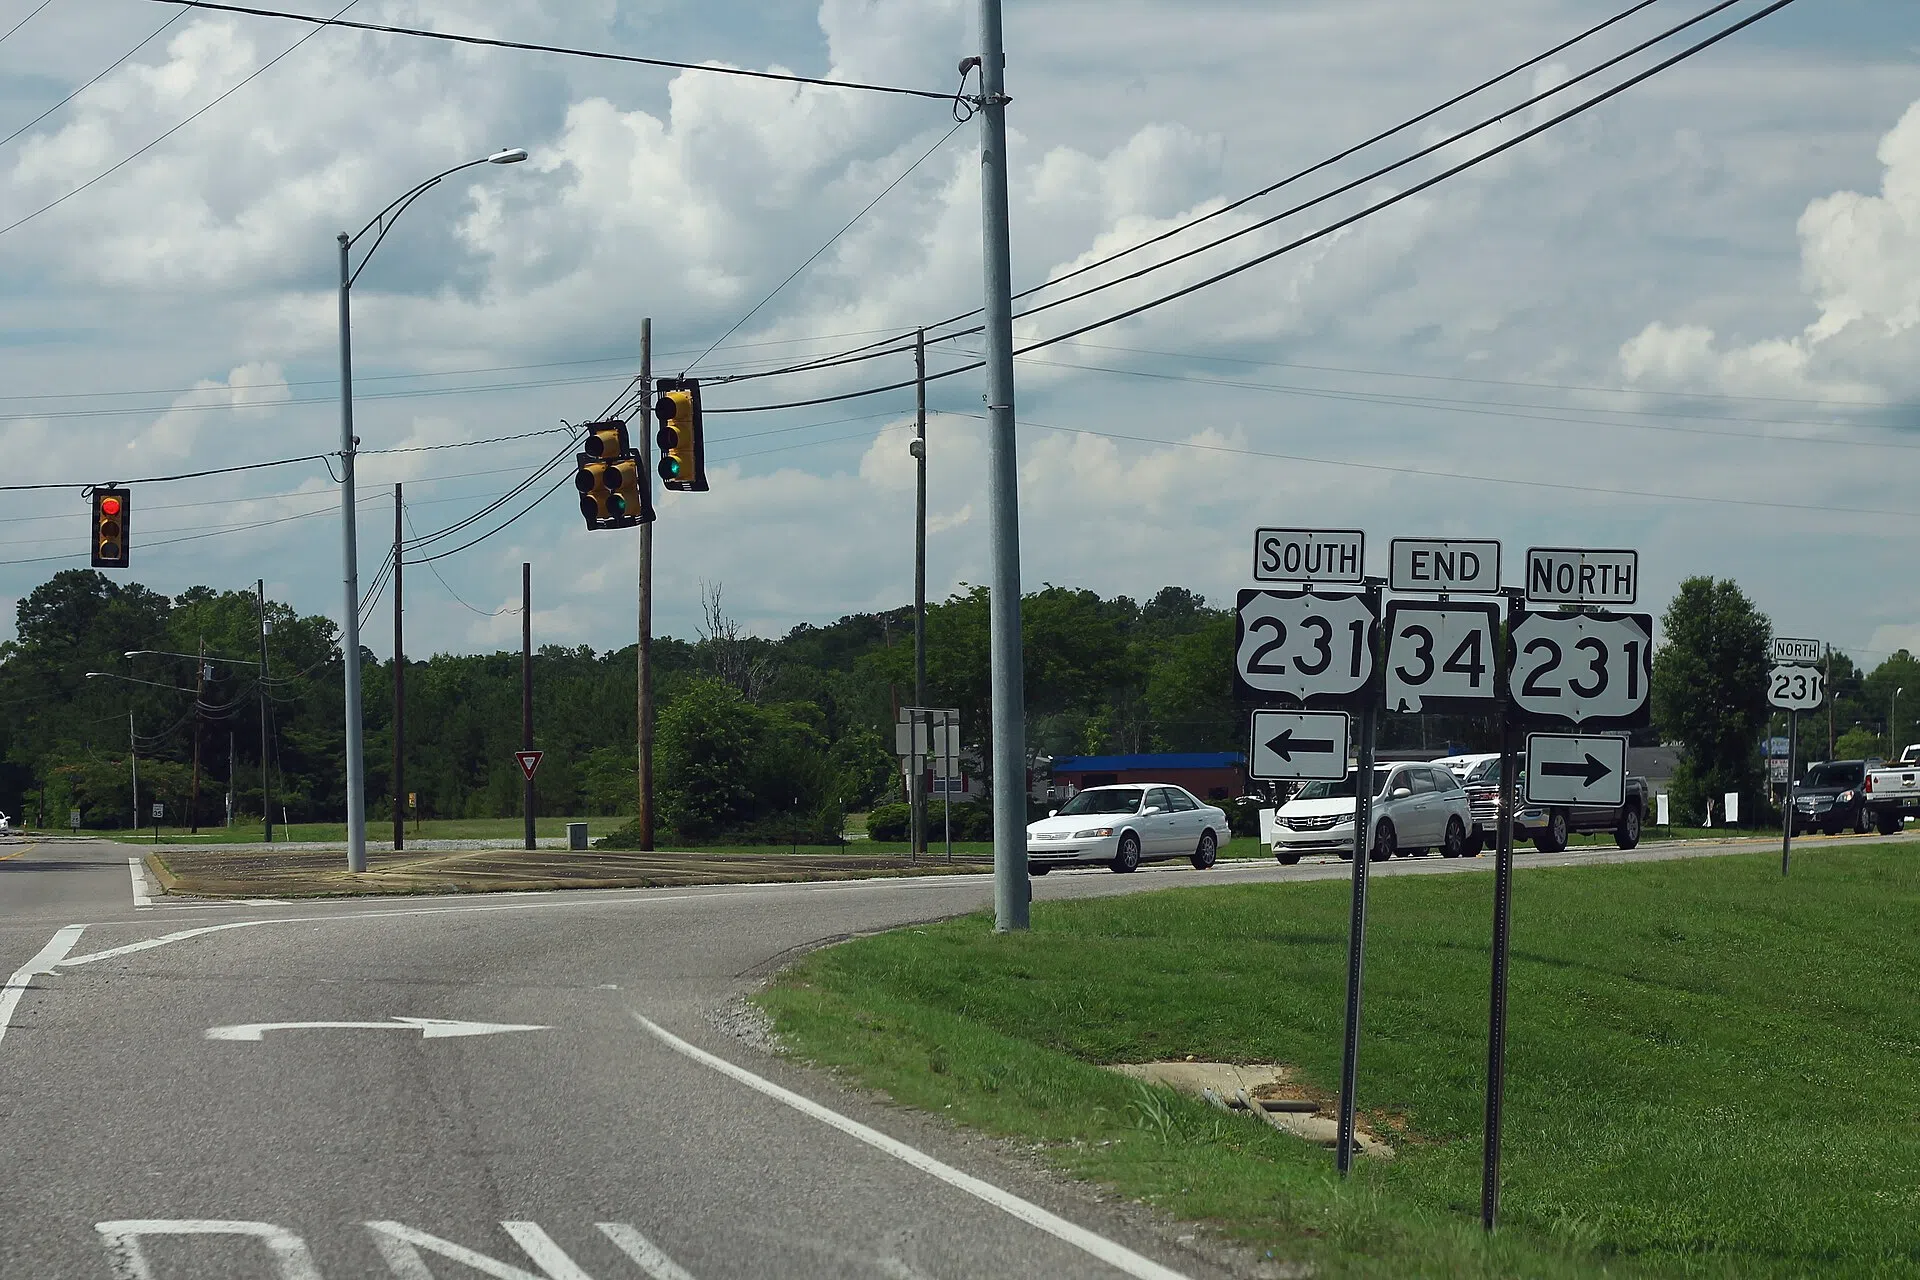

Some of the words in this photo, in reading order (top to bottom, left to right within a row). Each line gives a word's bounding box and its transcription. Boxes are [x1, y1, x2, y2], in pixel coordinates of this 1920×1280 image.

[1261, 537, 1357, 574] SOUTH
[1411, 550, 1480, 581] END
[1532, 557, 1632, 595] NORTH
[1246, 614, 1365, 678] 231
[1394, 624, 1486, 688] 34
[1777, 642, 1817, 658] NORTH
[1521, 636, 1639, 700] 231
[1773, 674, 1818, 701] 231
